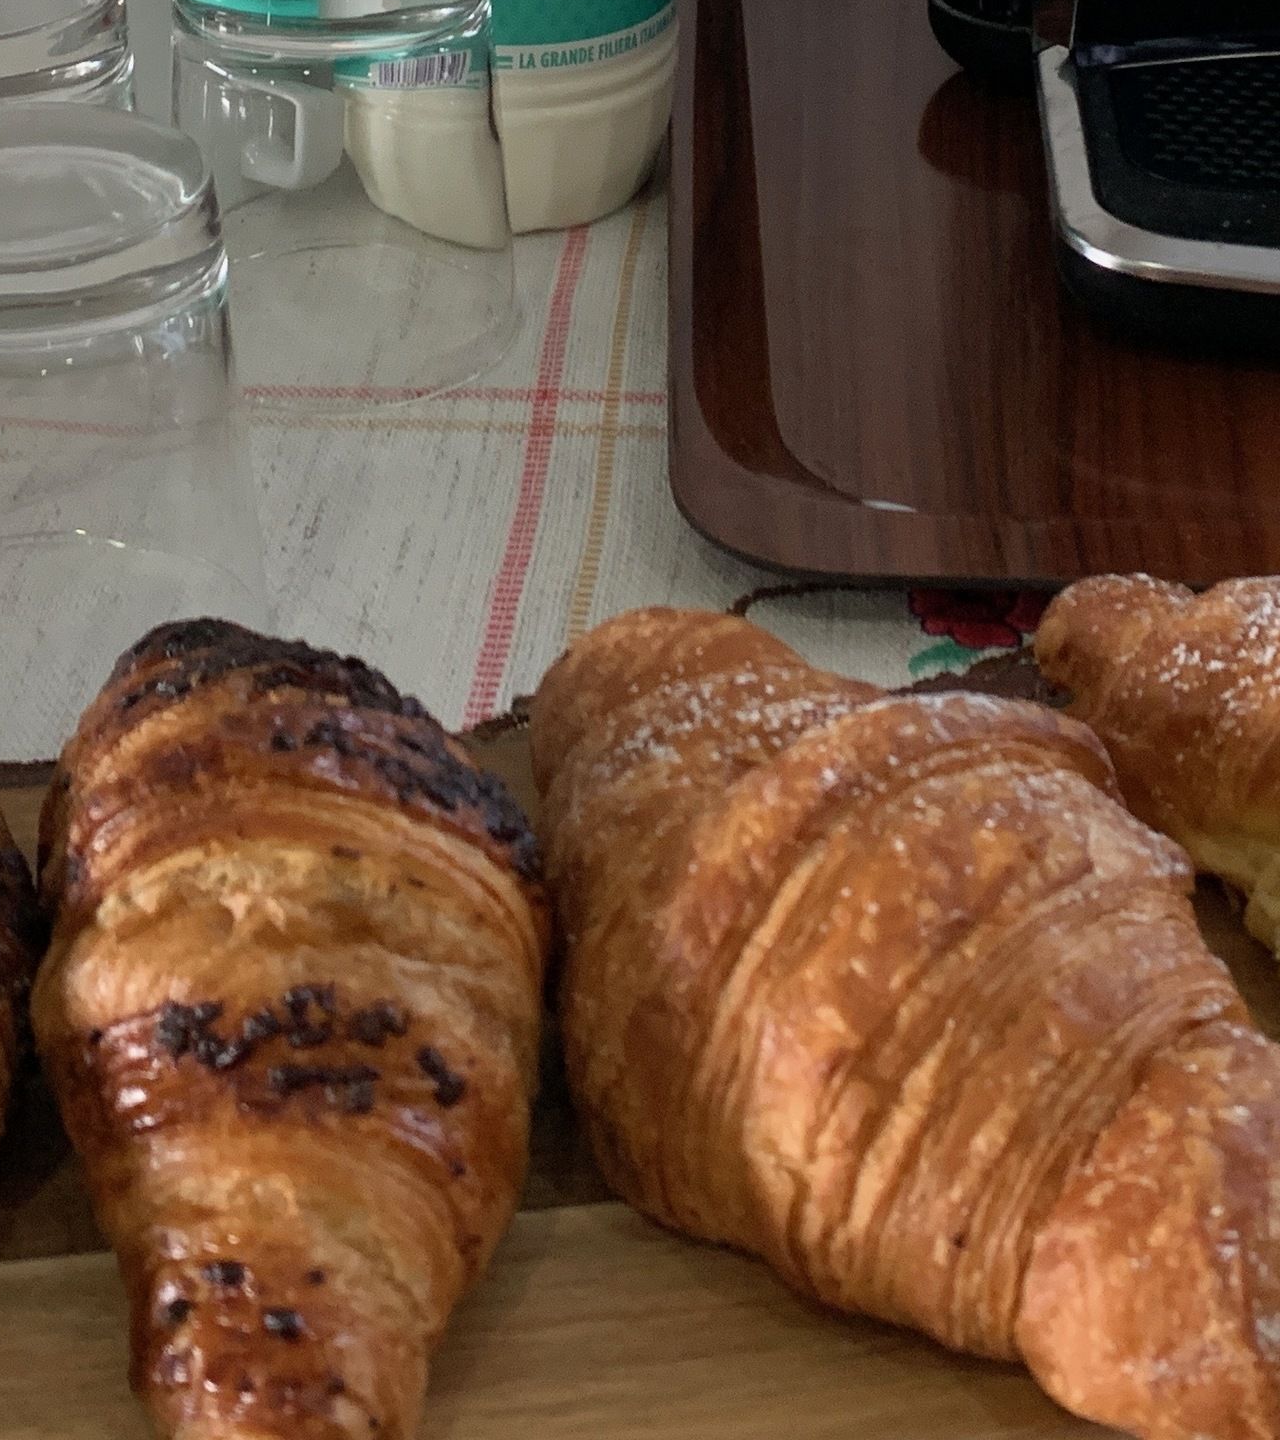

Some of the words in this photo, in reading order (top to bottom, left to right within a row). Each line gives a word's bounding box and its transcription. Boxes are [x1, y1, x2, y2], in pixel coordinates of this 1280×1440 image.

[518, 52, 537, 70] LA
[540, 44, 595, 69] GRANDE
[597, 32, 639, 61] FILIERA
